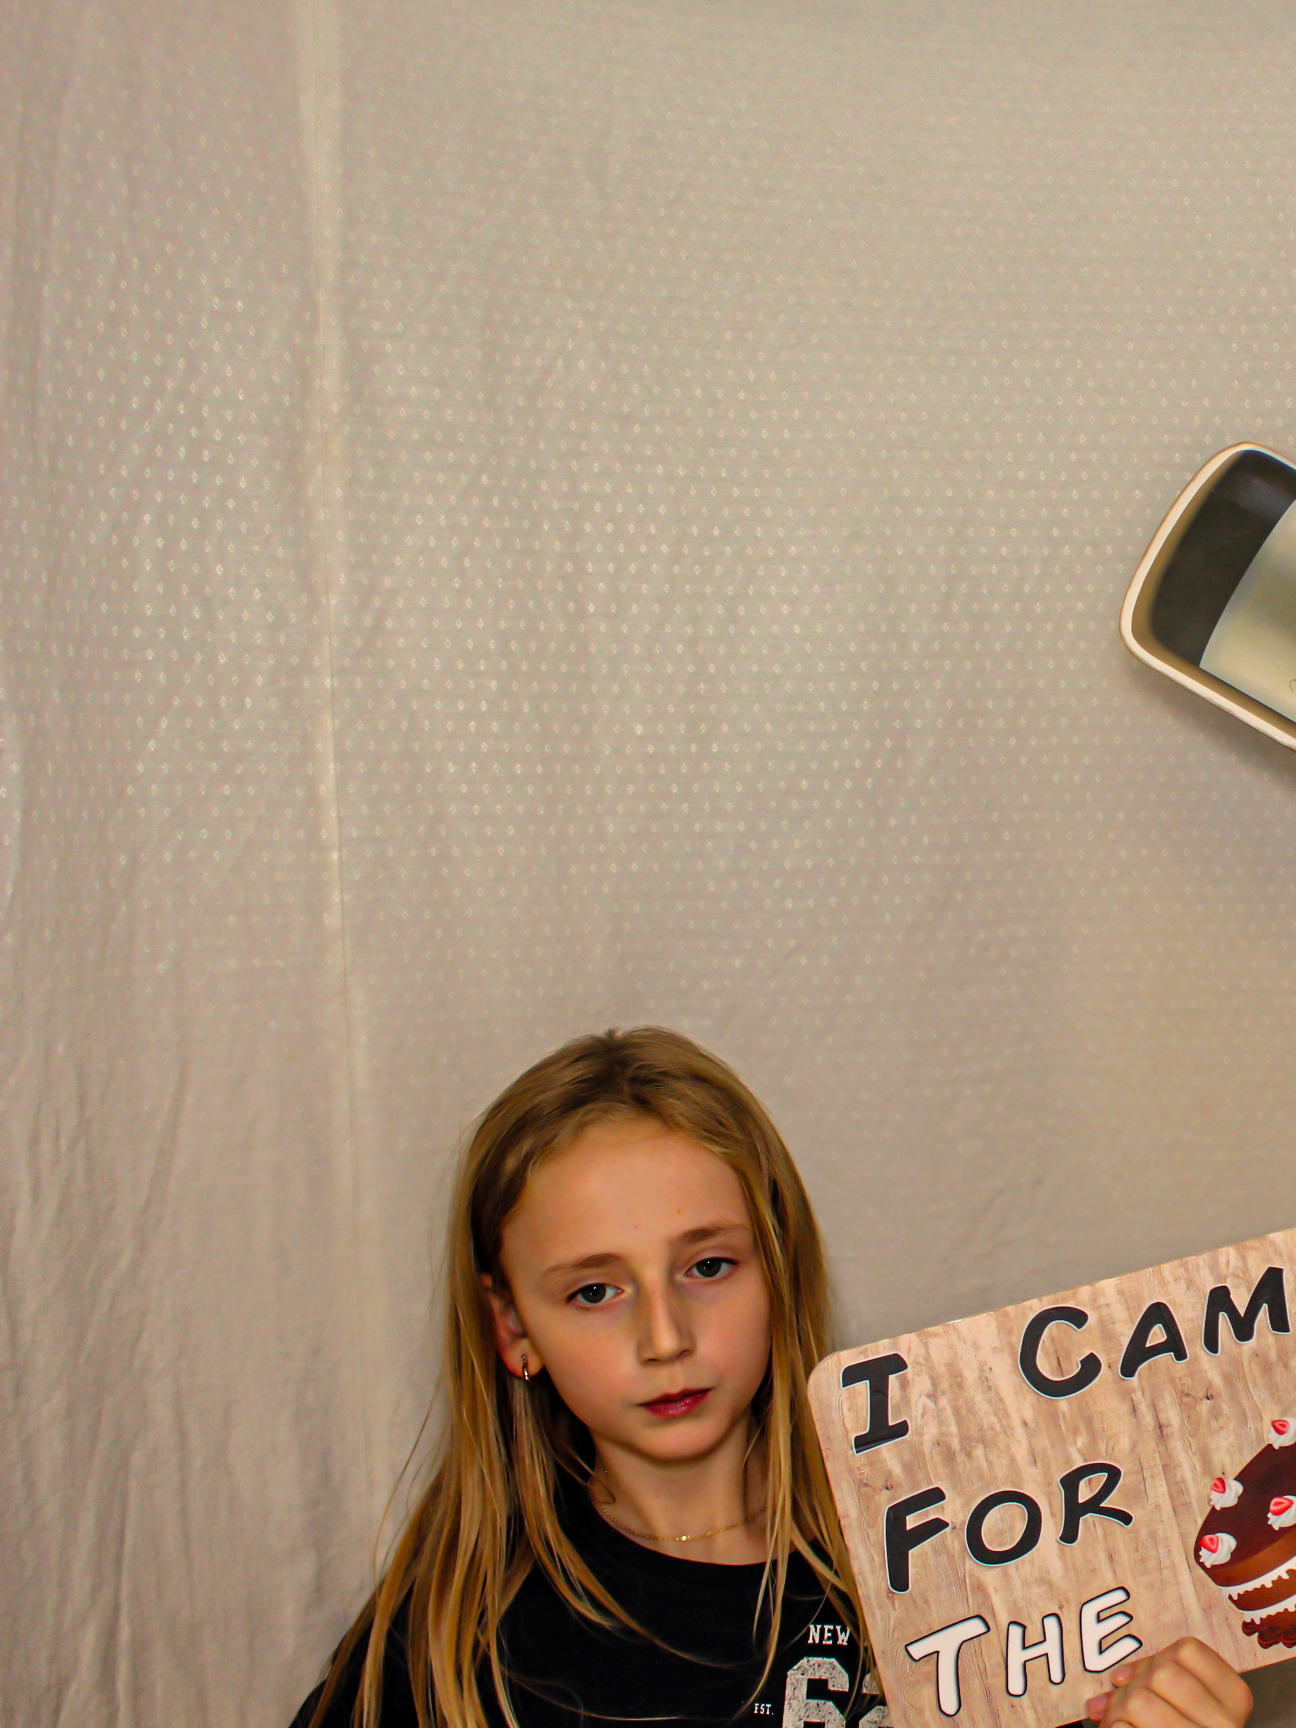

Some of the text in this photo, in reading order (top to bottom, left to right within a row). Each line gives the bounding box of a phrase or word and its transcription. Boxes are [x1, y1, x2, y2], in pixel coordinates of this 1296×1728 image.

[841, 1352, 909, 1454] I
[884, 1462, 1134, 1594] FOR
[807, 1624, 851, 1646] NEW
[904, 1585, 1143, 1717] THE
[753, 1703, 774, 1715] EST.
